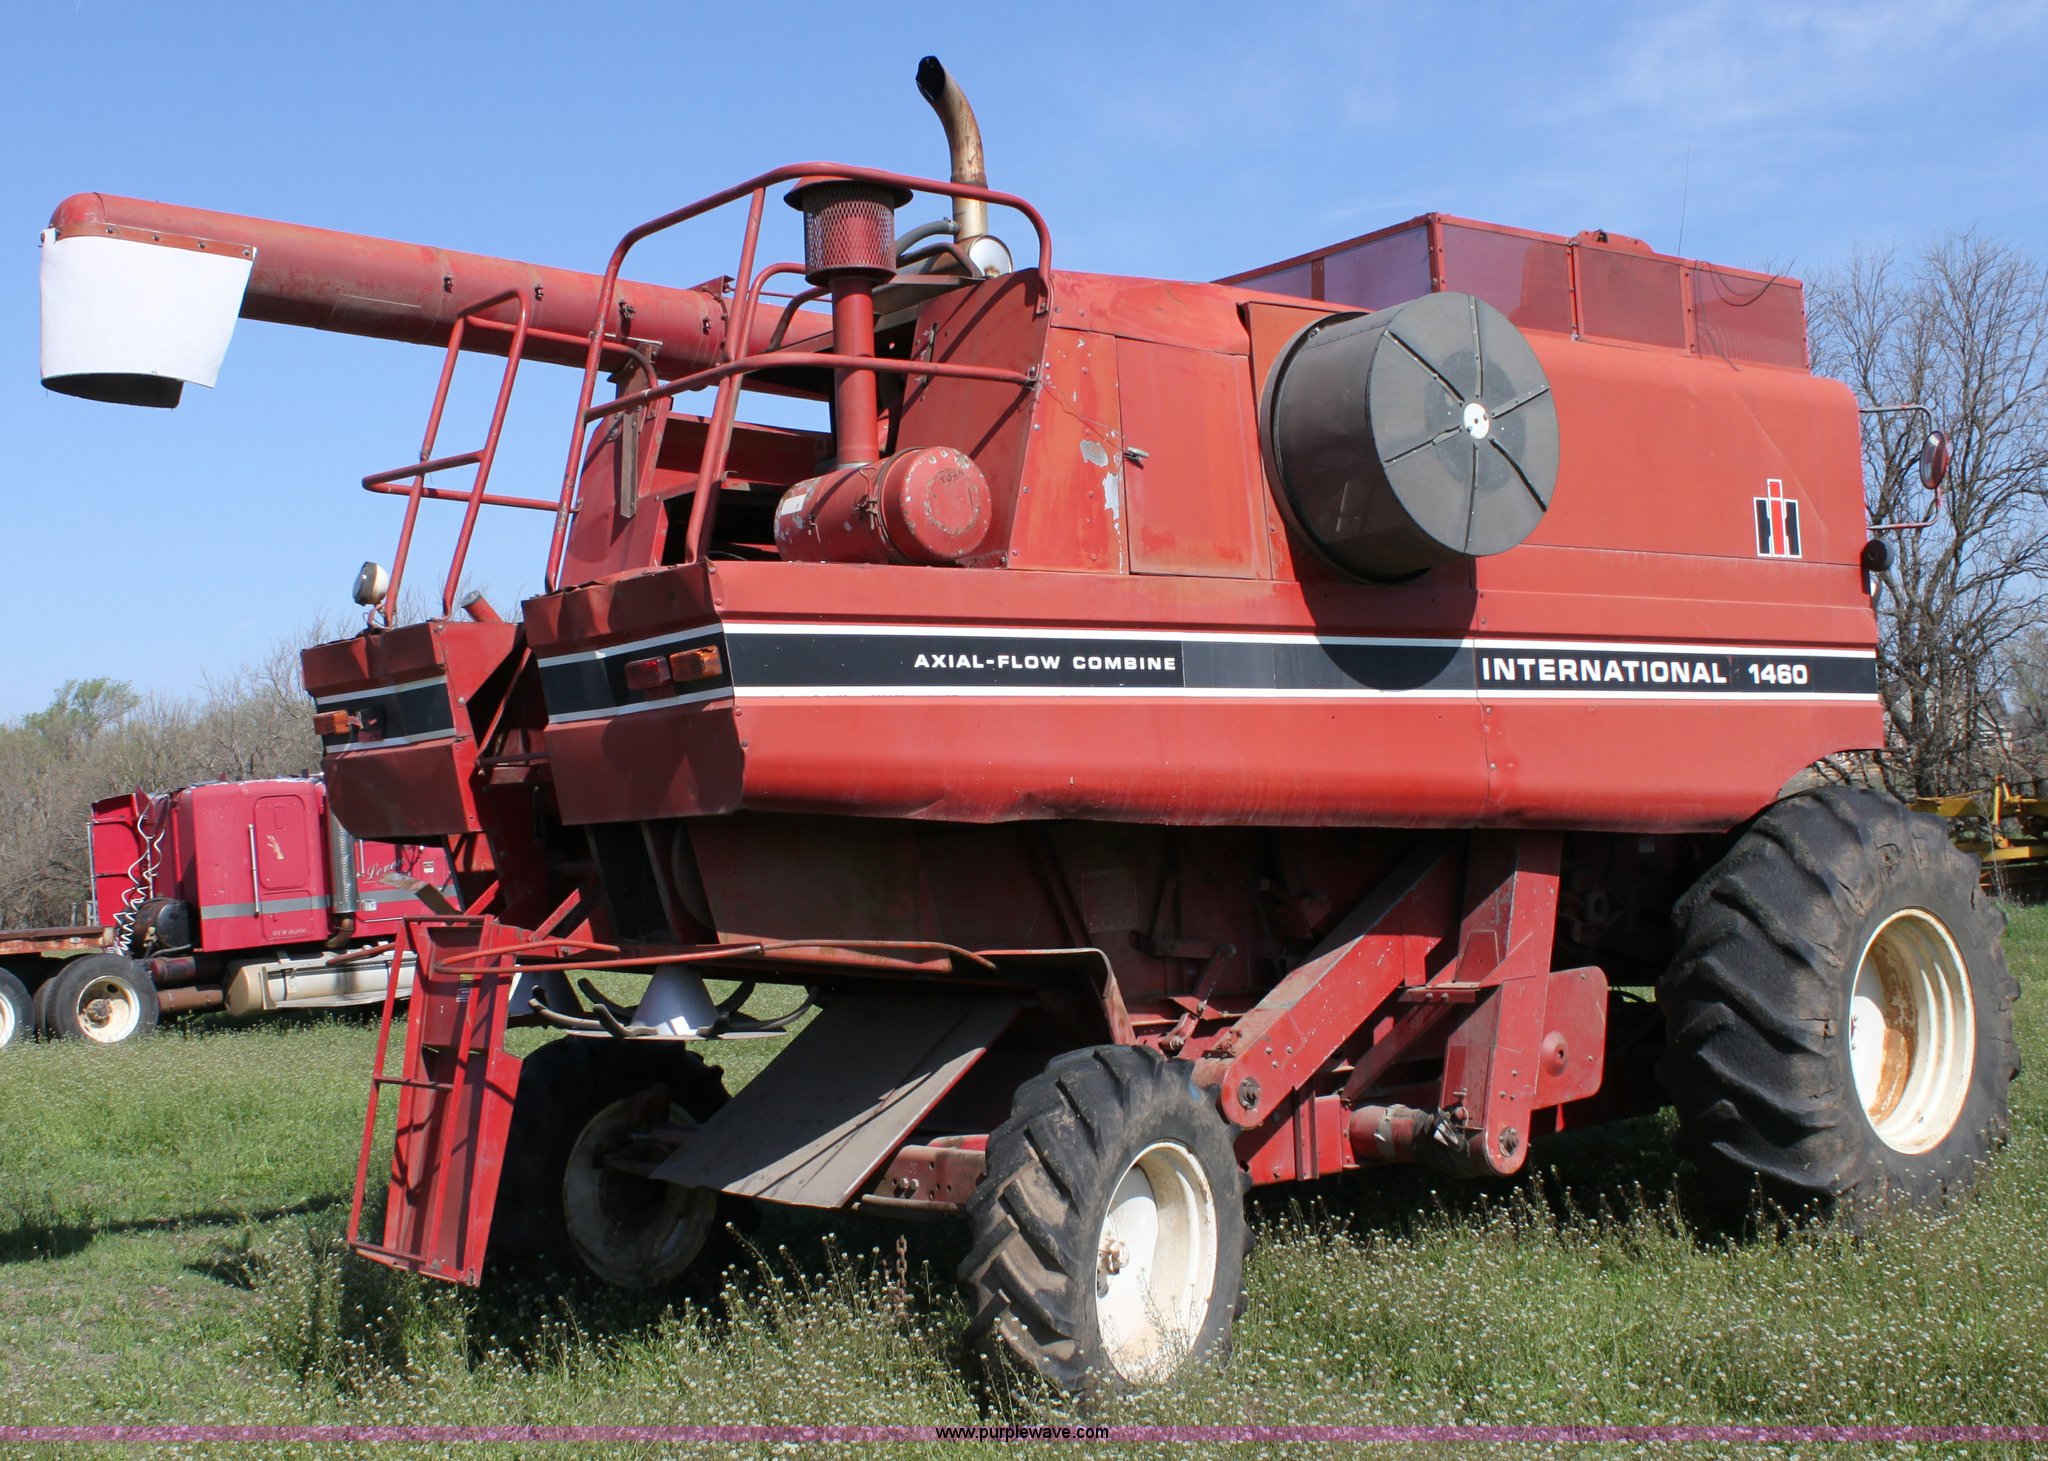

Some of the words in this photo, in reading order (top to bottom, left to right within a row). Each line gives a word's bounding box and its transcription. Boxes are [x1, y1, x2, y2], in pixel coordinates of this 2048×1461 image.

[914, 654, 1060, 670] AXIAL-FLOW
[1073, 656, 1175, 670] COMBINE
[1483, 658, 1726, 683] INTERNATIONAL
[1748, 664, 1808, 684] 1460
